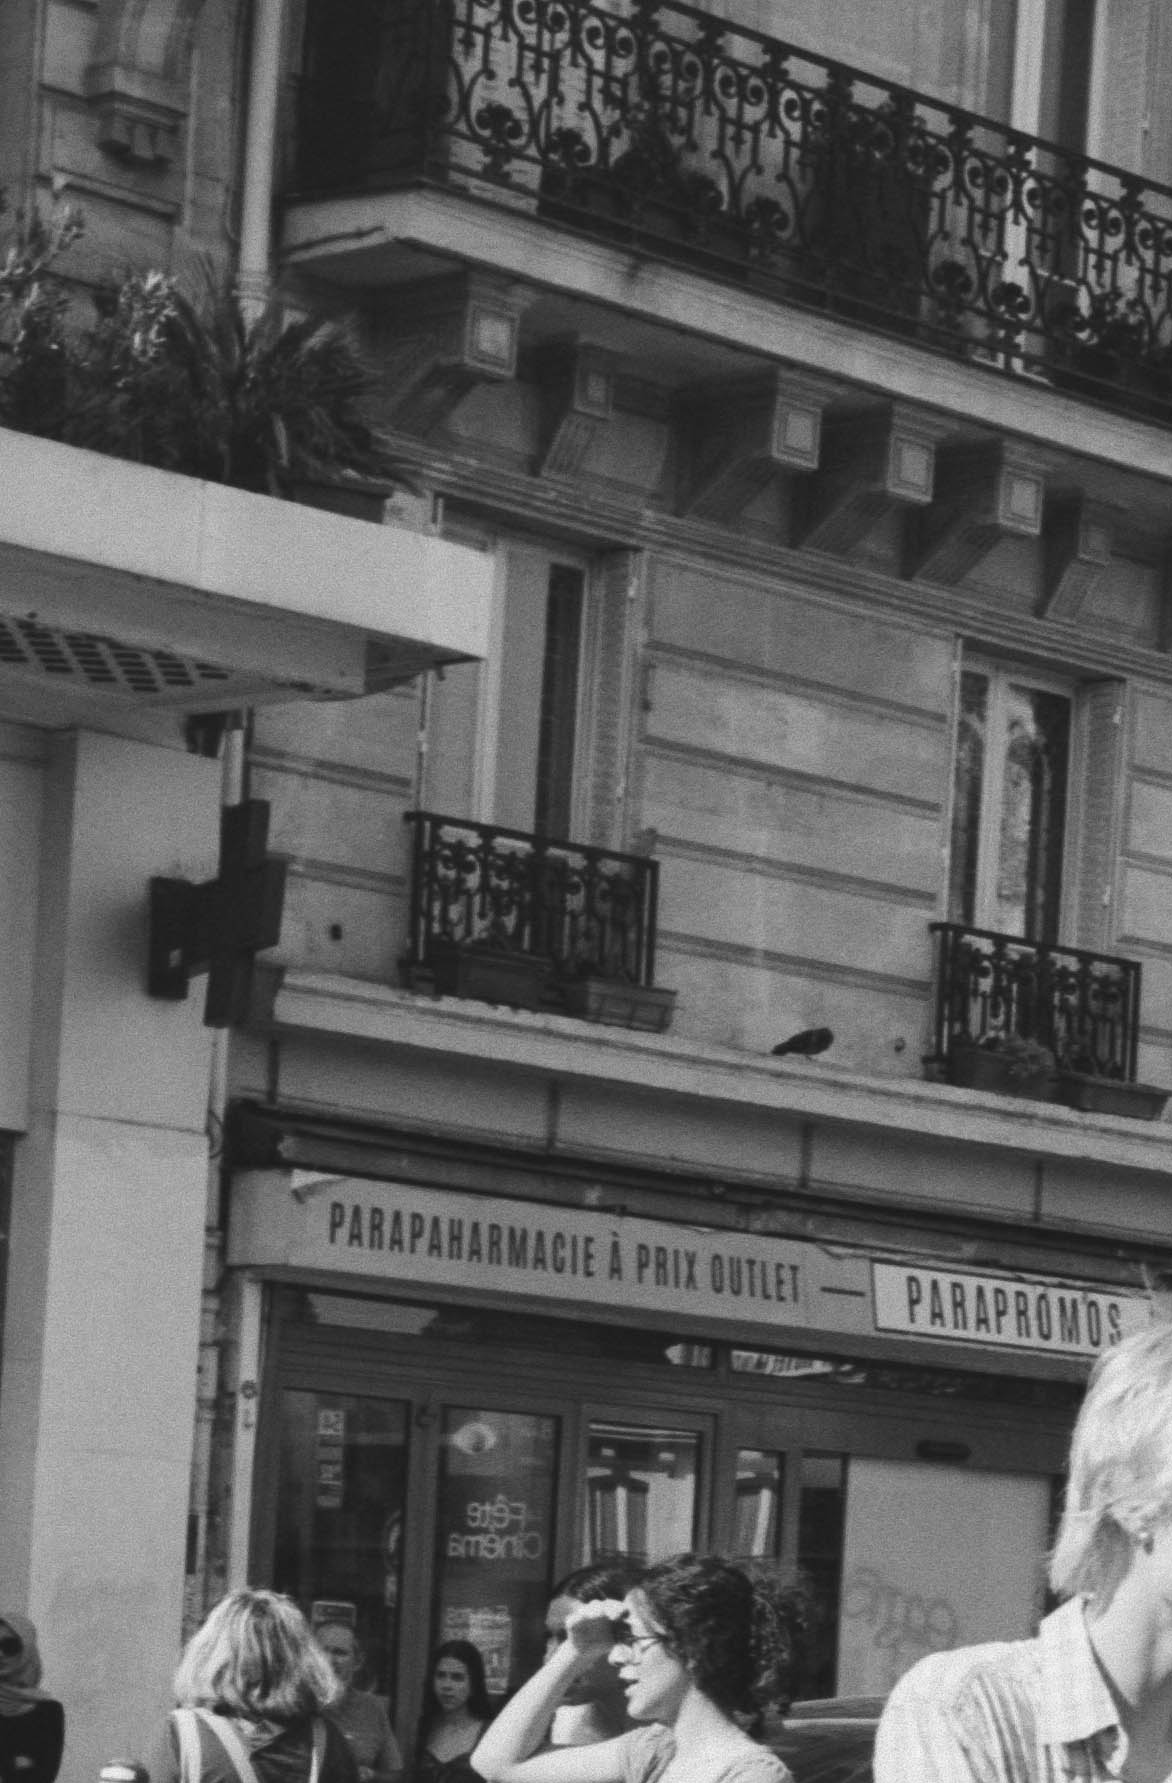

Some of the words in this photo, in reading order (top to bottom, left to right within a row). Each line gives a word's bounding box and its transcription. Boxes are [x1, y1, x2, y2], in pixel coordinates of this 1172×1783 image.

[329, 1200, 595, 1278] PARAPAHARMACIE
[609, 1230, 623, 1281] À
[636, 1242, 698, 1291] PRIX
[709, 1253, 801, 1304] OUTLET
[906, 1274, 1122, 1348] PARAPROMOS
